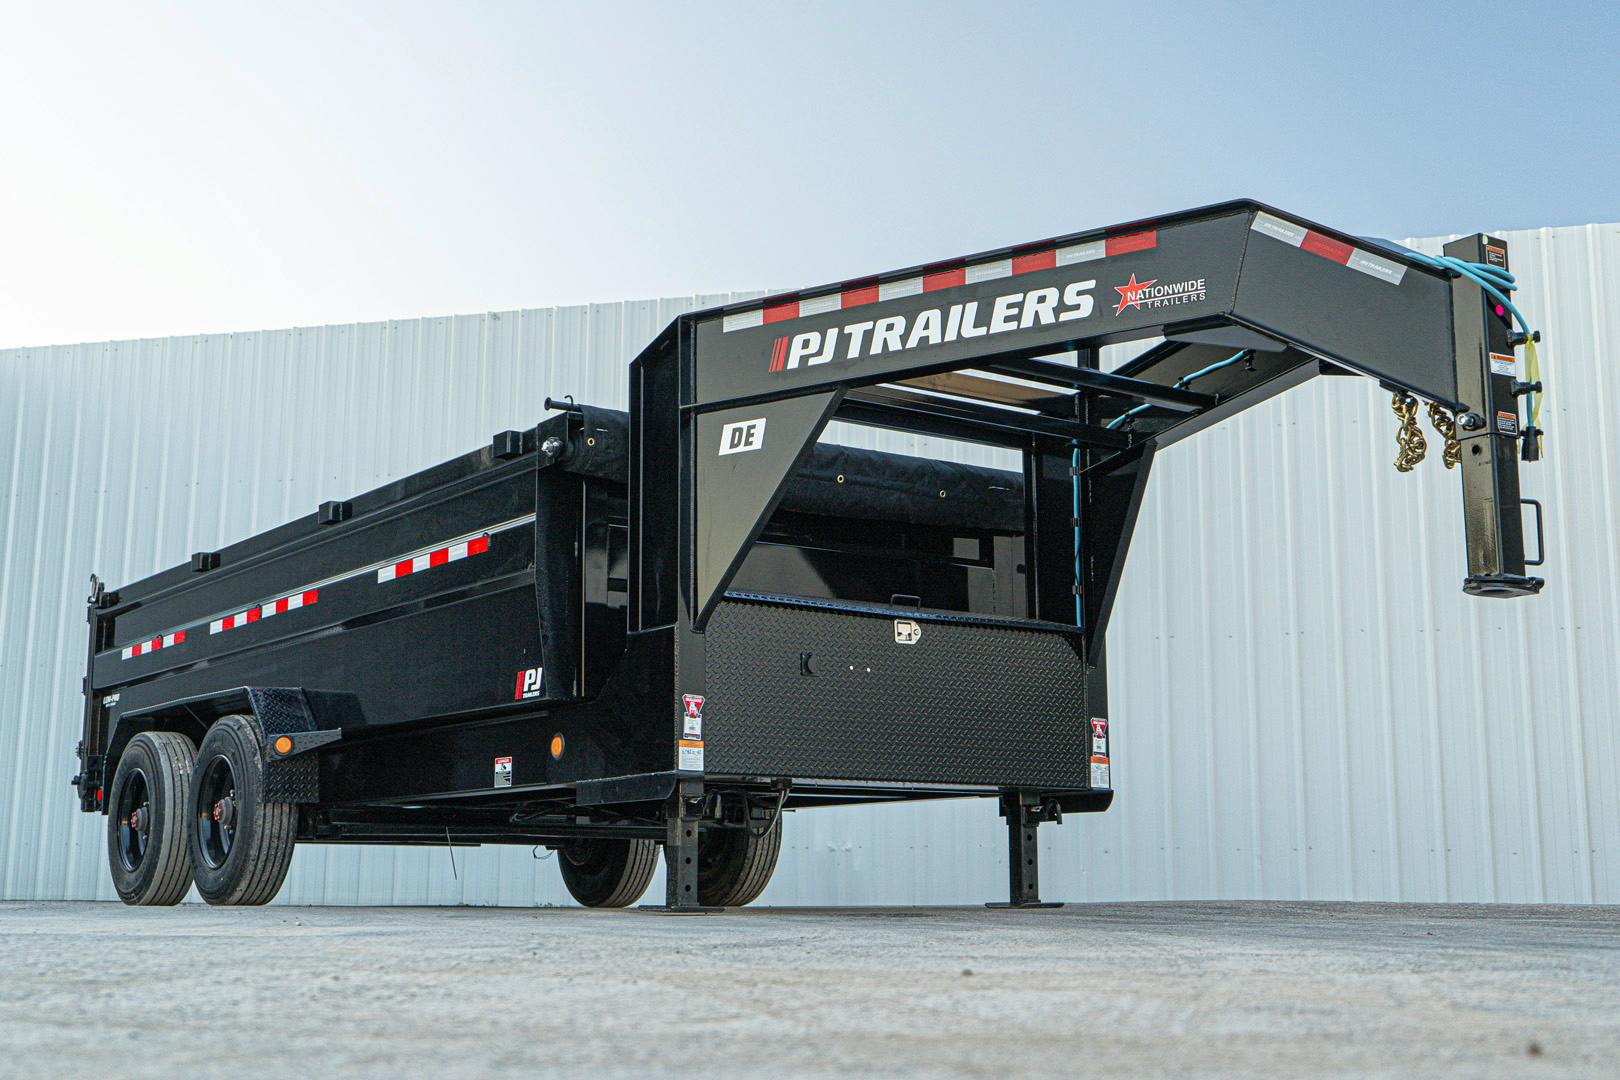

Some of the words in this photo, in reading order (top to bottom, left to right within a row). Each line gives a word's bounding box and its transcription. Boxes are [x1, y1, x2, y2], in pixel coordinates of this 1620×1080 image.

[1127, 278, 1206, 302] NATIONWIDE
[1147, 292, 1206, 309] TRAILERS
[787, 328, 839, 370] PJ
[844, 279, 1097, 360] TRAILERS
[729, 423, 757, 449] DE
[523, 667, 543, 692] PJ
